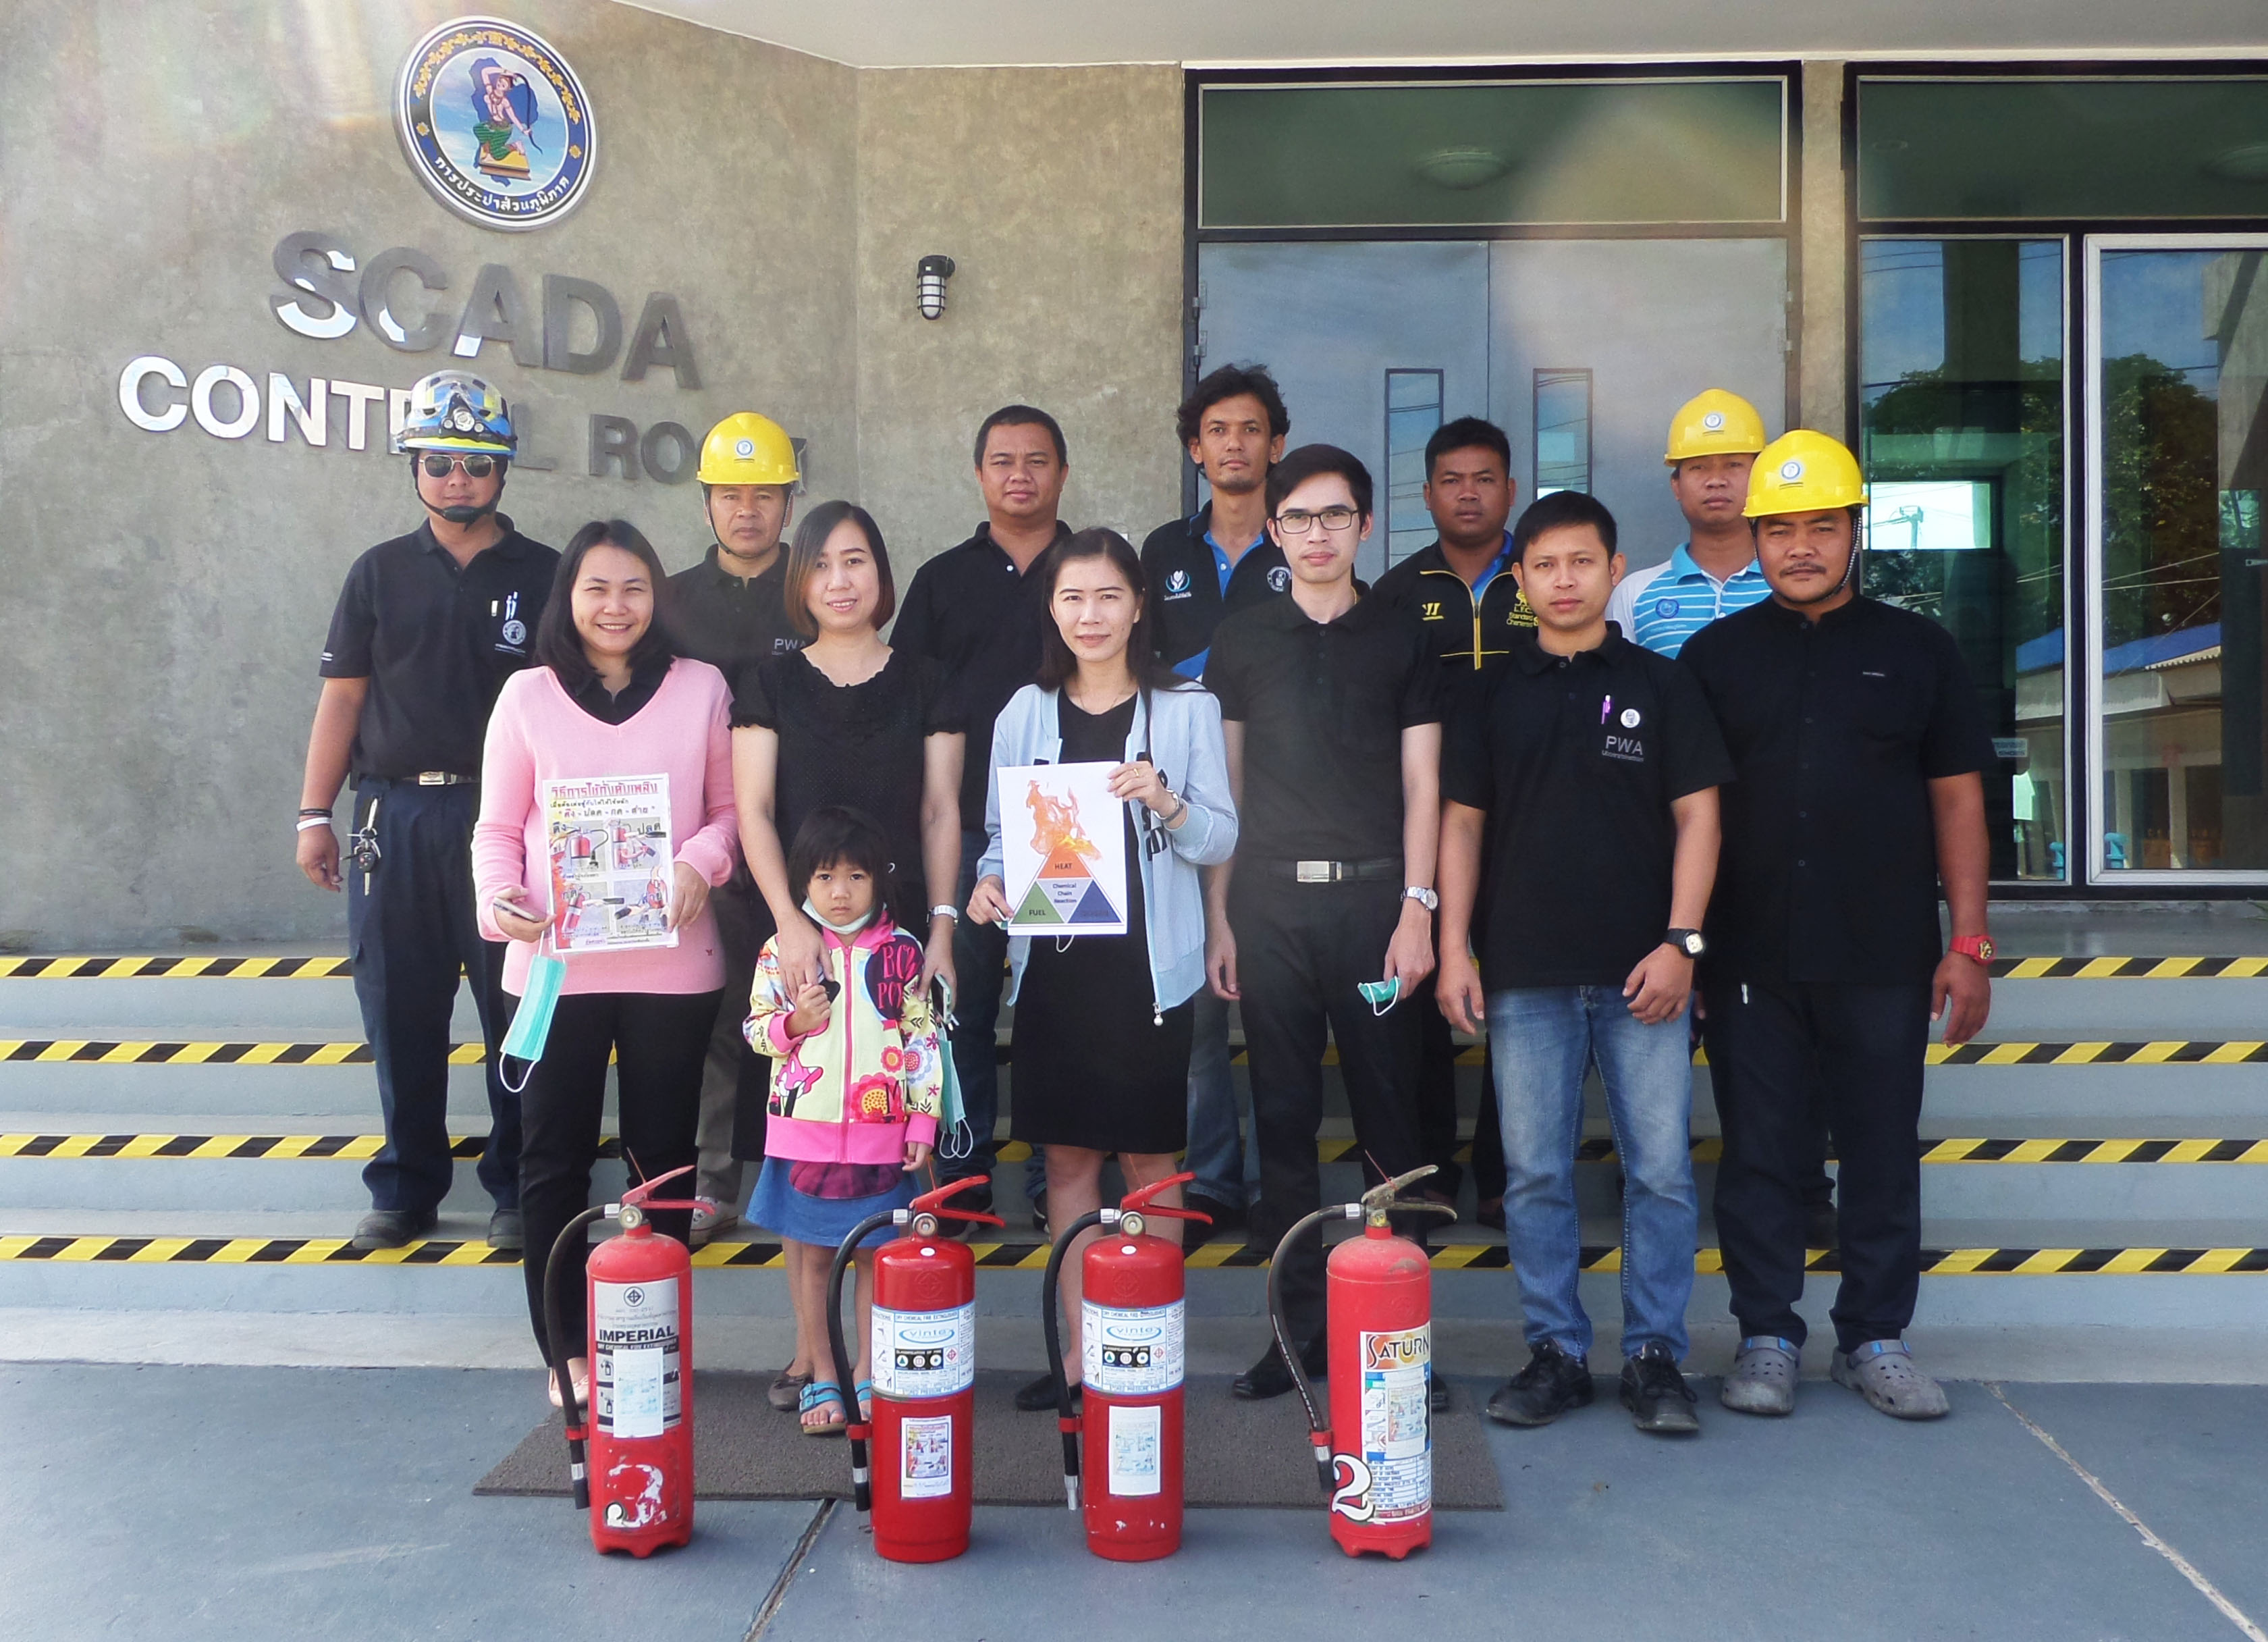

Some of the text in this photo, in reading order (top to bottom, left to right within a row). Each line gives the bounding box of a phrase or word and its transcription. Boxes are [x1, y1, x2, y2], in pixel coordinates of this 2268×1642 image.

[271, 230, 703, 391] SCADA
[118, 355, 556, 472] CONTL
[1606, 735, 1643, 756] PWA
[599, 1325, 675, 1342] IMPERIAL
[1368, 1335, 1429, 1369] SATURN
[1332, 1454, 1375, 1522] 2
